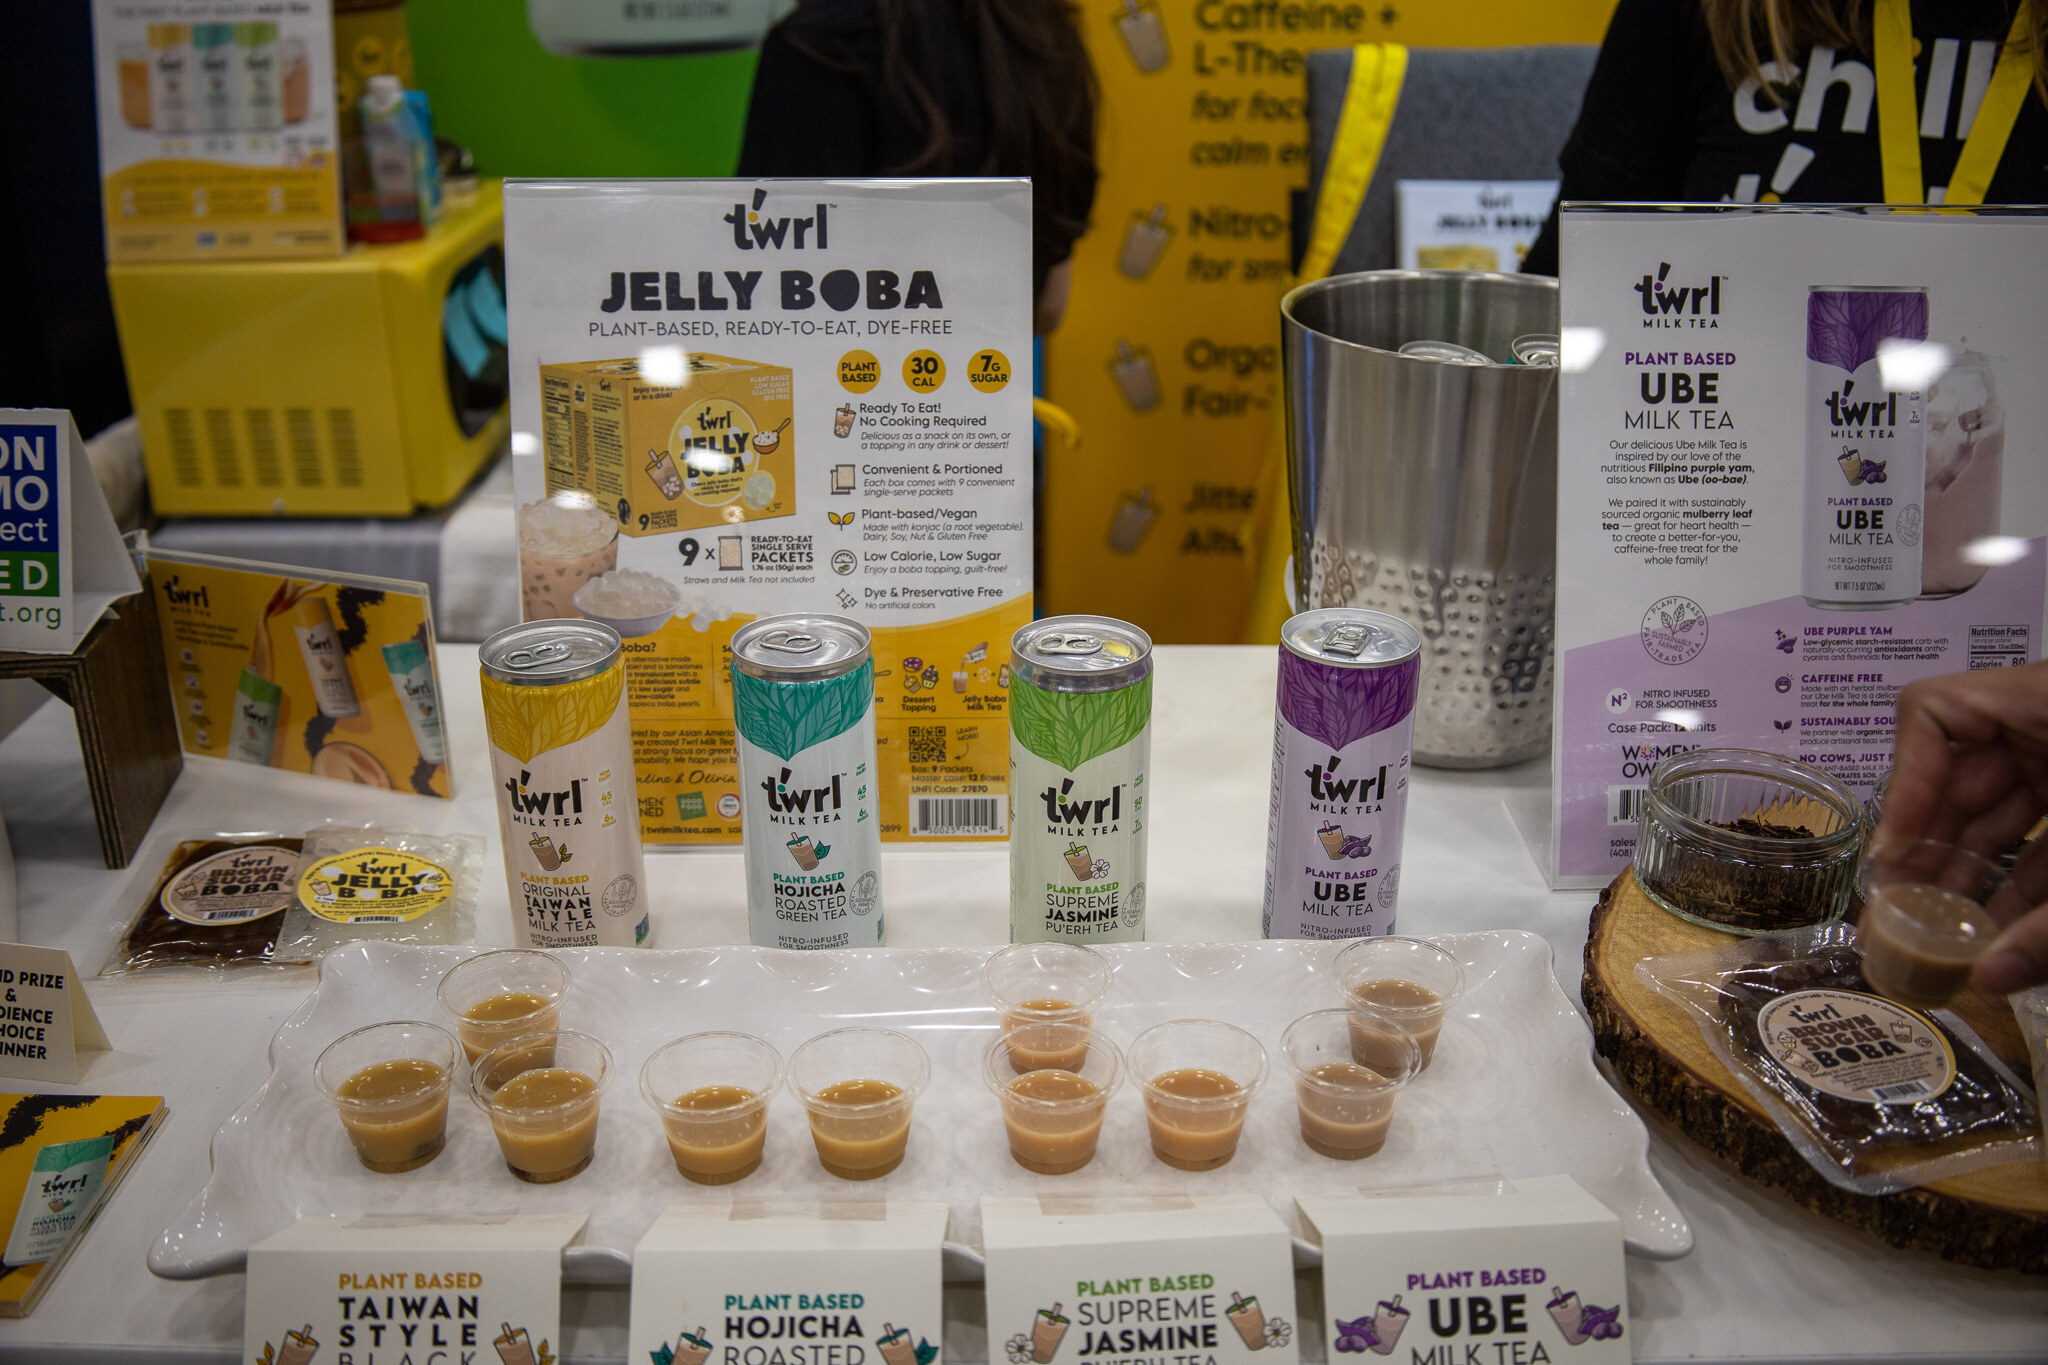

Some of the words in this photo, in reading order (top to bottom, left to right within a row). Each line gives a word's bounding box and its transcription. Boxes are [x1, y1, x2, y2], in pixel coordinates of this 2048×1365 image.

[1733, 38, 1996, 139] chll
[600, 270, 763, 313] JELLY
[780, 269, 943, 312] BOBA
[588, 321, 720, 338] PLANT-BASED,
[725, 320, 862, 337] READY-TO-EAT,
[868, 320, 953, 335] DYE-FREE
[1643, 319, 1681, 328] MILK
[1689, 319, 1718, 328] TEA
[912, 357, 938, 374] 30
[981, 355, 1000, 372] 7G
[1625, 352, 1678, 365] PLANT
[1684, 352, 1736, 365] BASED
[842, 362, 876, 371] PLANT
[842, 373, 876, 382] BASED
[912, 378, 936, 387] CAL
[971, 374, 1008, 382] SUGAR
[1641, 372, 1719, 404] UBE
[860, 403, 897, 415] Ready
[901, 403, 915, 412] To
[919, 403, 941, 412] Eat!
[860, 417, 876, 426] No
[880, 417, 930, 428] Cooking
[934, 416, 986, 427] Required
[1625, 410, 1680, 429] MILK
[1690, 410, 1734, 429] TEA
[861, 432, 900, 440] Delicious
[924, 432, 949, 440] snack
[966, 432, 976, 440] its
[1609, 440, 1628, 449] Our
[1631, 440, 1673, 449] delicious
[1675, 440, 1695, 449] Ube
[1699, 440, 1716, 449] Milk
[1720, 440, 1737, 449] Tea
[1740, 440, 1747, 449] is
[1615, 452, 1654, 462] inspired
[1656, 452, 1668, 462] by
[1671, 453, 1687, 461] our
[1690, 452, 1710, 461] love
[1713, 452, 1723, 461] of
[1725, 452, 1741, 461] the
[862, 508, 977, 520] Plant-based/Vegan
[678, 538, 700, 566] 9
[751, 552, 813, 562] PACKETS
[1804, 627, 1825, 636] UBE
[1827, 627, 1866, 636] PURPLE
[1869, 627, 1892, 636] YAM
[1971, 628, 2005, 637] Nutrition
[2007, 628, 2027, 637] Facts
[1802, 674, 1853, 682] CAFFEINE
[1857, 674, 1883, 682] FREE
[963, 696, 982, 704] Jelly
[902, 704, 936, 712] Topping
[1801, 717, 1870, 726] SUSTAINABLY
[1310, 802, 1349, 815] MILK
[1356, 804, 1381, 815] TEA
[513, 815, 546, 827] MILK
[553, 816, 582, 827] TEA
[770, 814, 805, 825] MILK
[813, 813, 841, 824] TEA
[1047, 825, 1084, 837] MILK
[1092, 824, 1118, 836] TEA
[211, 865, 288, 878] BROWN
[520, 871, 550, 884] PLANT
[553, 873, 589, 884] BASED
[773, 872, 806, 884] PLANT
[810, 871, 845, 883] BASED
[1305, 867, 1341, 880] PLANT
[1344, 867, 1377, 880] BASED
[207, 874, 284, 886] SUGAR
[331, 873, 428, 889] JELLY
[201, 882, 281, 896] BOBA
[337, 886, 418, 899] BOBA
[522, 882, 590, 896] ORIGINAL
[774, 882, 845, 897] HOJICHA
[1047, 882, 1081, 895] PLANT
[1085, 881, 1119, 894] BASED
[1314, 882, 1367, 901] UBE
[524, 894, 591, 909] TAIWAN
[775, 896, 846, 911] ROASTED
[1046, 893, 1119, 908] SUPREME
[527, 906, 593, 921] STYLE
[776, 909, 819, 922] GREEN
[825, 909, 847, 920] TEA
[1046, 906, 1118, 921] JASMINE
[1302, 901, 1339, 917] MILK
[1346, 901, 1374, 916] TEA
[529, 918, 559, 933] MILK
[565, 920, 596, 931] TEA
[1095, 921, 1118, 933] TEA
[19, 971, 64, 989] PRIZE
[5, 988, 17, 1002] &
[1787, 1013, 1877, 1039] BROWN
[1800, 1027, 1889, 1050] SUGAR
[1812, 1040, 1906, 1068] BOBA
[339, 1273, 407, 1289] PLANT
[414, 1272, 483, 1289] BASED
[1077, 1278, 1142, 1297] PLANT
[1149, 1274, 1214, 1293] BASED
[1407, 1271, 1473, 1290] PLANT
[1480, 1268, 1546, 1287] BASED
[339, 1296, 478, 1319] TAIWAN
[725, 1295, 791, 1310] PLANT
[798, 1294, 865, 1310] BASED
[1078, 1294, 1216, 1326] SUPREME
[1428, 1294, 1528, 1338] UBE
[725, 1315, 864, 1339] HOJICHA
[339, 1323, 477, 1347] STYLE
[1078, 1324, 1217, 1356] JASMINE
[725, 1345, 865, 1365] ROASTED
[1412, 1343, 1482, 1365] MILK
[1493, 1341, 1551, 1365] TEA
